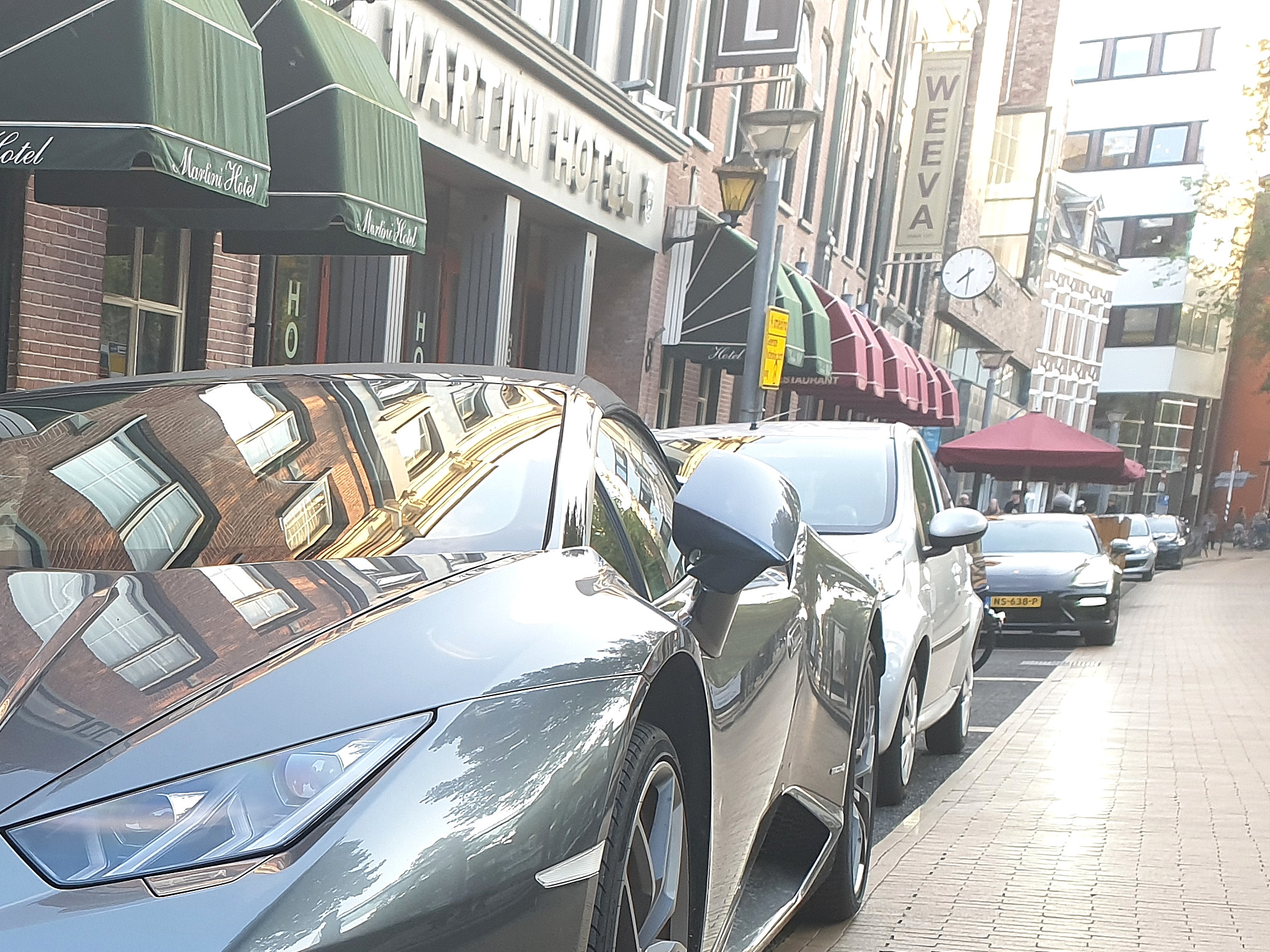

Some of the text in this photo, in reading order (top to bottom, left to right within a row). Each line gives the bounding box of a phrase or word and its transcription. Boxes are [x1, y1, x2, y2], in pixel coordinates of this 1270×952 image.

[391, 0, 633, 218] MARTINI HOTEL
[172, 147, 258, 198] Martini Hotel
[909, 75, 960, 229] WEEVA
[357, 208, 417, 247] Martini Hotel
[708, 346, 745, 359] Hotel
